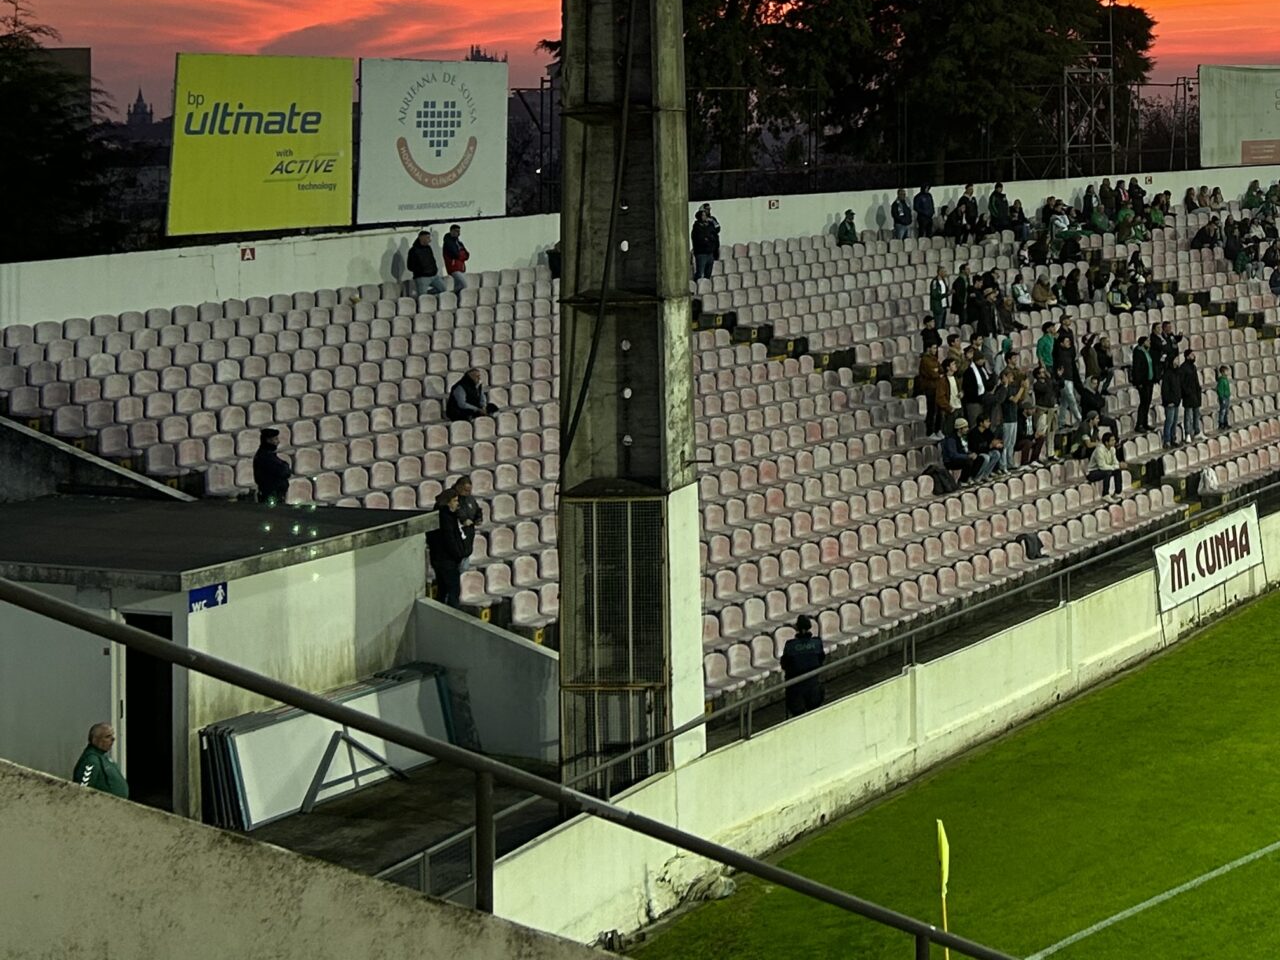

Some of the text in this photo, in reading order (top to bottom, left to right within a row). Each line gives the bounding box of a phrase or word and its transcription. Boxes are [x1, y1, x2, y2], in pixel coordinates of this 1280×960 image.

[187, 91, 205, 108] bp
[398, 72, 478, 125] ARRIFANA DE SOUSA
[184, 102, 322, 136] ultimate
[276, 149, 293, 157] with
[270, 159, 337, 175] ACTIVE
[297, 182, 337, 191] technology
[244, 248, 253, 260] A
[191, 600, 207, 613] WC
